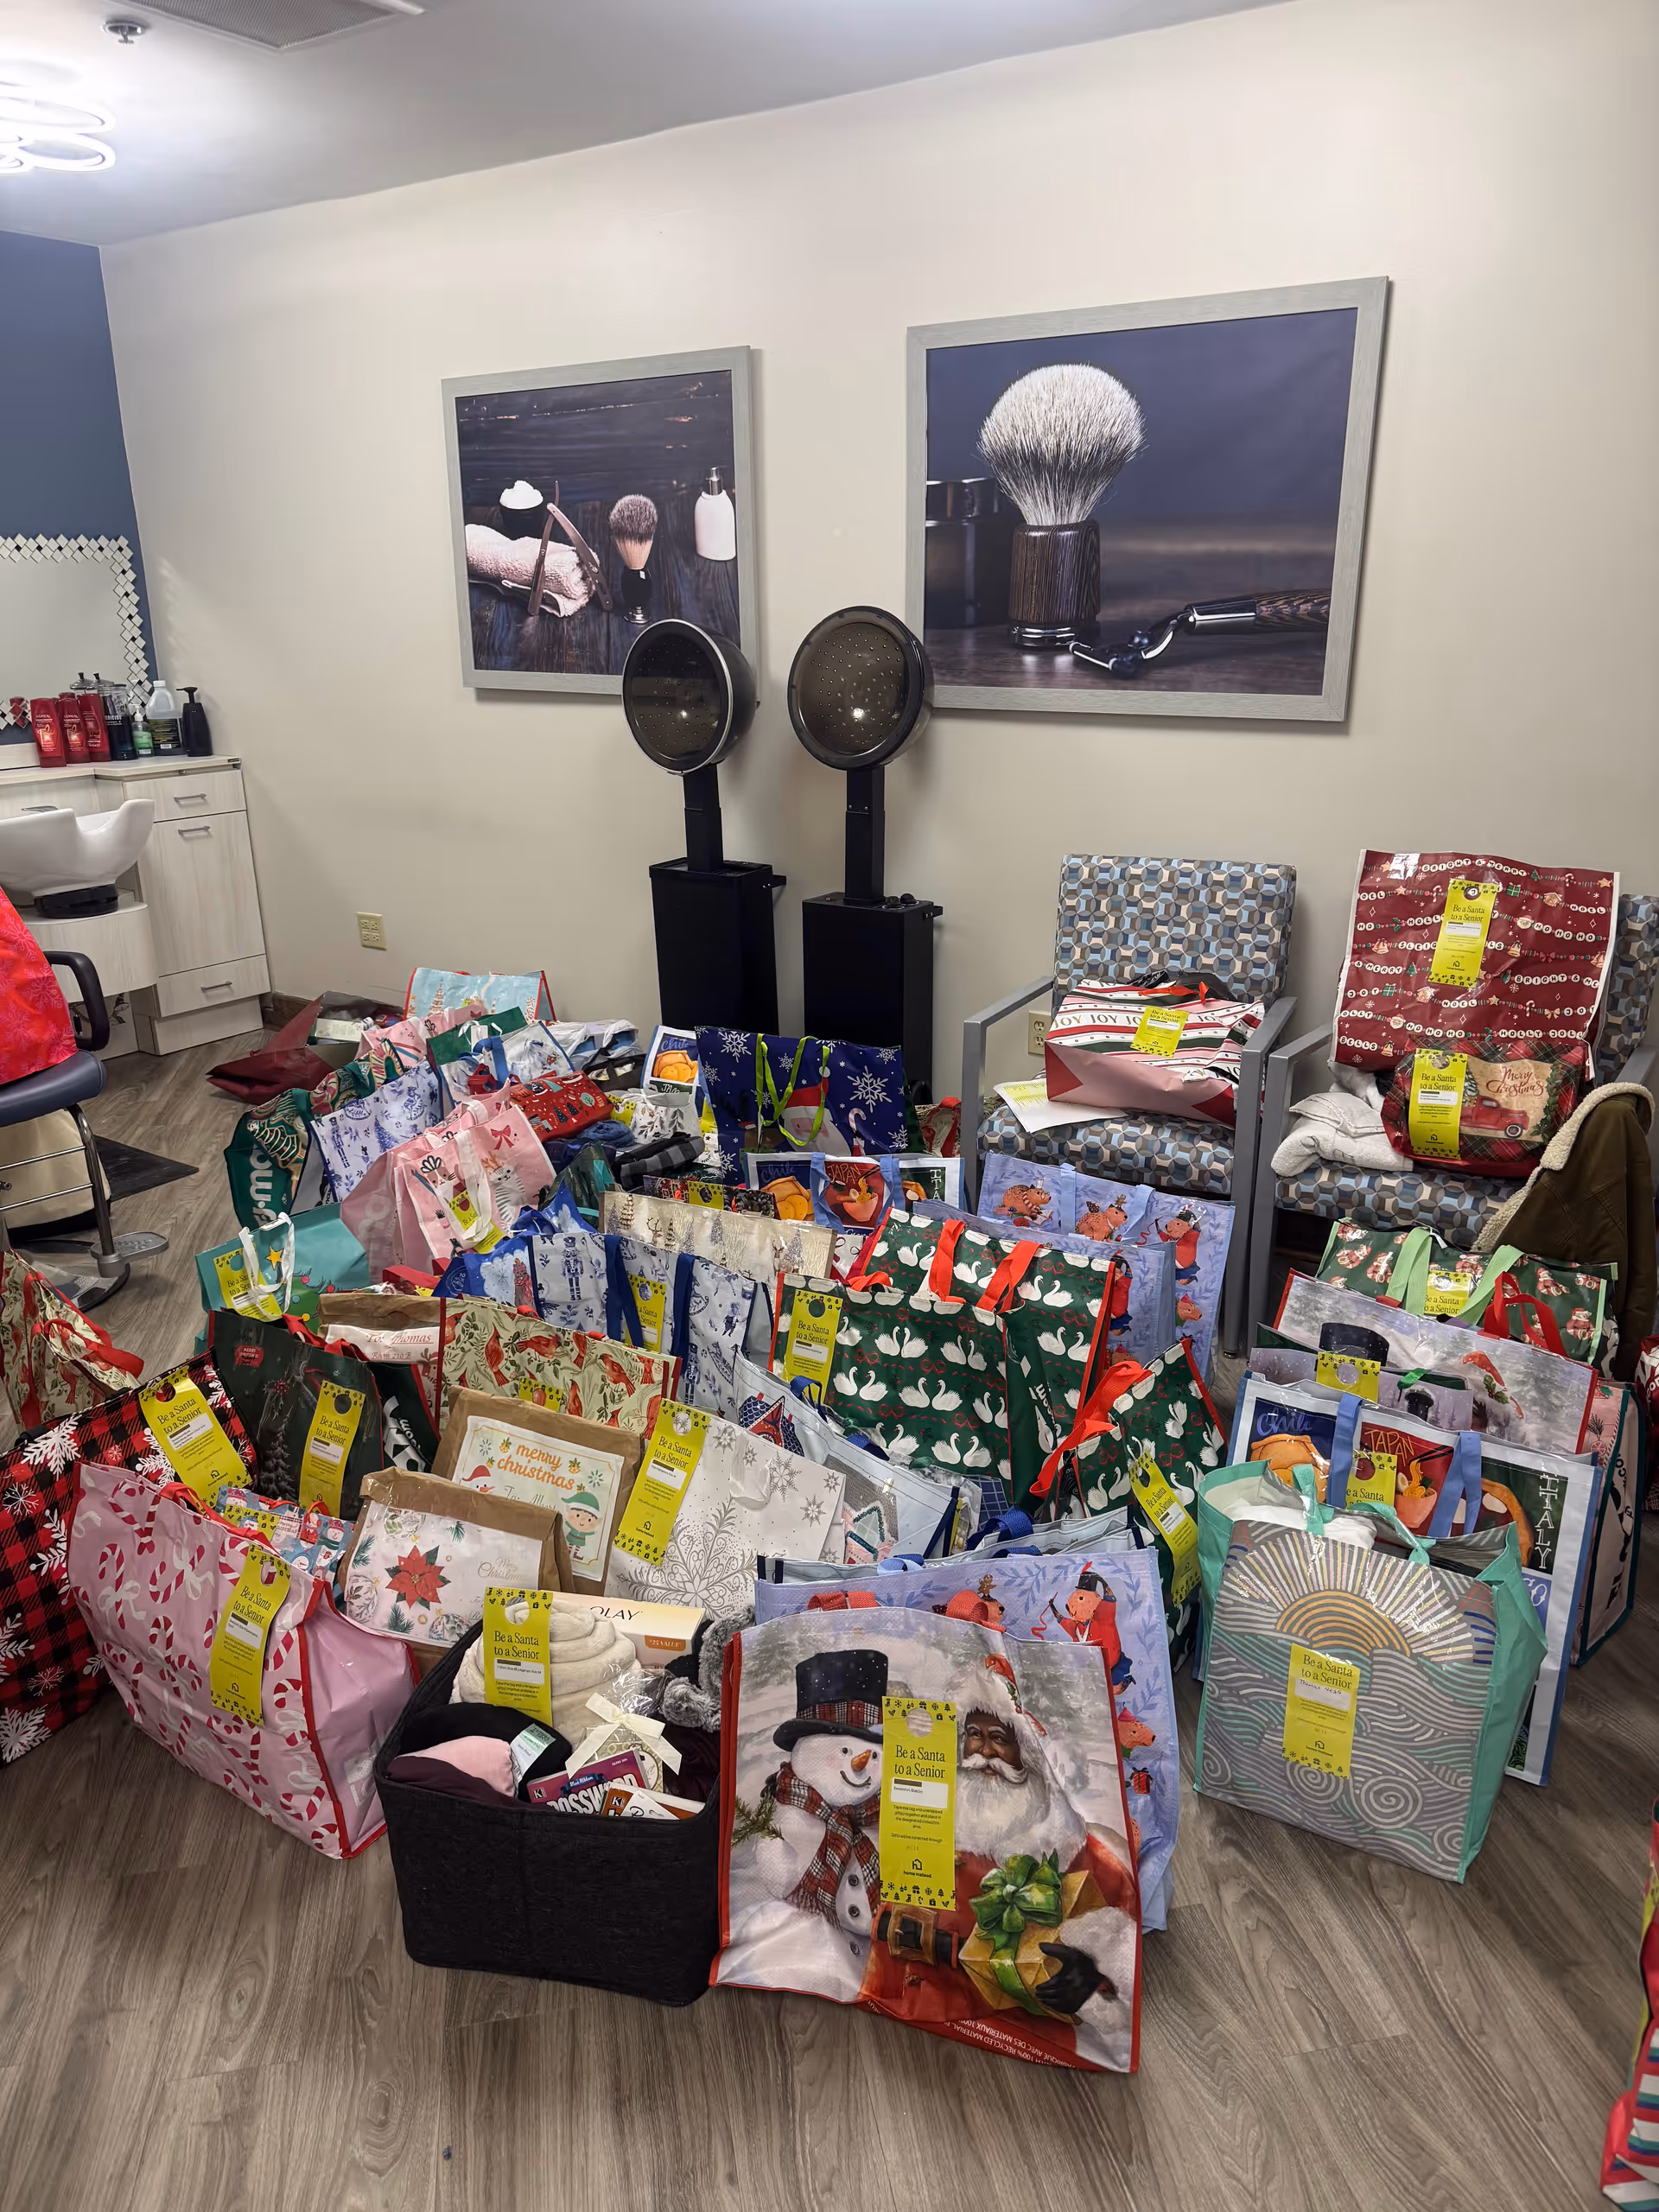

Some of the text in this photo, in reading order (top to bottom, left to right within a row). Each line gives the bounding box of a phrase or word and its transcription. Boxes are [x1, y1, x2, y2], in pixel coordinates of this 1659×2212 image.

[1422, 859, 1471, 872] BRIGHT
[1487, 861, 1527, 876] MERRY
[1570, 903, 1606, 914] NOEL
[1357, 921, 1375, 931] HO
[1407, 915, 1444, 926] HOLL
[1534, 922, 1595, 943] HO HO HO
[1398, 941, 1438, 951] SLEIG
[1365, 963, 1403, 975] MERRY
[1514, 973, 1567, 985] BRIGHT
[1346, 987, 1380, 998] JOY
[1441, 998, 1478, 1008] NOEL
[1054, 1014, 1082, 1028] JOY
[1090, 1014, 1117, 1024] JOY
[1126, 1015, 1141, 1026] JO
[1405, 1021, 1465, 1039] HO HO HO
[1499, 1029, 1543, 1039] HOLLY
[1339, 1036, 1378, 1051] BELLS
[1437, 1074, 1457, 1083] Santa
[1502, 1065, 1533, 1087] Merry
[1434, 1083, 1456, 1091] Senior
[1485, 1079, 1545, 1097] Christmas
[827, 1164, 861, 1185] JAPAN
[1439, 1296, 1459, 1305] Santa
[643, 1306, 658, 1318] Santa
[1436, 1305, 1459, 1314] Senior
[640, 1315, 657, 1327] Senior
[798, 1320, 806, 1329] Be
[812, 1324, 830, 1335] Santa
[366, 1332, 432, 1345] To: Thomas
[808, 1332, 829, 1344] Senior
[157, 1414, 168, 1425] Be
[175, 1398, 197, 1414] Santa
[164, 1425, 173, 1434] to
[179, 1407, 201, 1425] Senior
[320, 1415, 328, 1427] Be
[333, 1421, 350, 1433] Santa
[1257, 1407, 1312, 1436] Chile
[316, 1428, 322, 1437] to
[327, 1430, 346, 1445] Senior
[658, 1436, 667, 1447] Be
[673, 1441, 692, 1457] Santa
[517, 1444, 563, 1471] merry
[654, 1449, 662, 1459] to
[667, 1452, 688, 1469] Senior
[498, 1455, 575, 1491] christmas
[1146, 1499, 1152, 1509] Be
[1156, 1487, 1166, 1500] Santa
[1360, 1488, 1384, 1502] Santa
[1154, 1510, 1160, 1519] to
[1163, 1497, 1173, 1512] Senior
[1535, 1474, 1560, 1569] ITALY
[240, 1586, 249, 1598] Be
[252, 1593, 271, 1611] Santa
[233, 1601, 239, 1611] to
[244, 1605, 264, 1624] Senior
[494, 1630, 539, 1646] Be a Santa
[494, 1646, 503, 1656] to
[512, 1646, 539, 1659] Senior
[1303, 1654, 1315, 1666] Be
[1325, 1661, 1352, 1677] Santa
[1301, 1669, 1311, 1678] to
[1321, 1673, 1352, 1689] Senior
[895, 1745, 945, 1762] Be a Santa
[895, 1763, 945, 1778] to a Senior
[579, 1776, 594, 1785] Ribbon
[976, 2022, 1013, 2044] MATÉRIAUX
[983, 2037, 1016, 2055] RECYCLED
[1013, 2039, 1026, 2049] DES
[1027, 2044, 1042, 2056] AVEC
[1016, 2050, 1034, 2063] 100%
